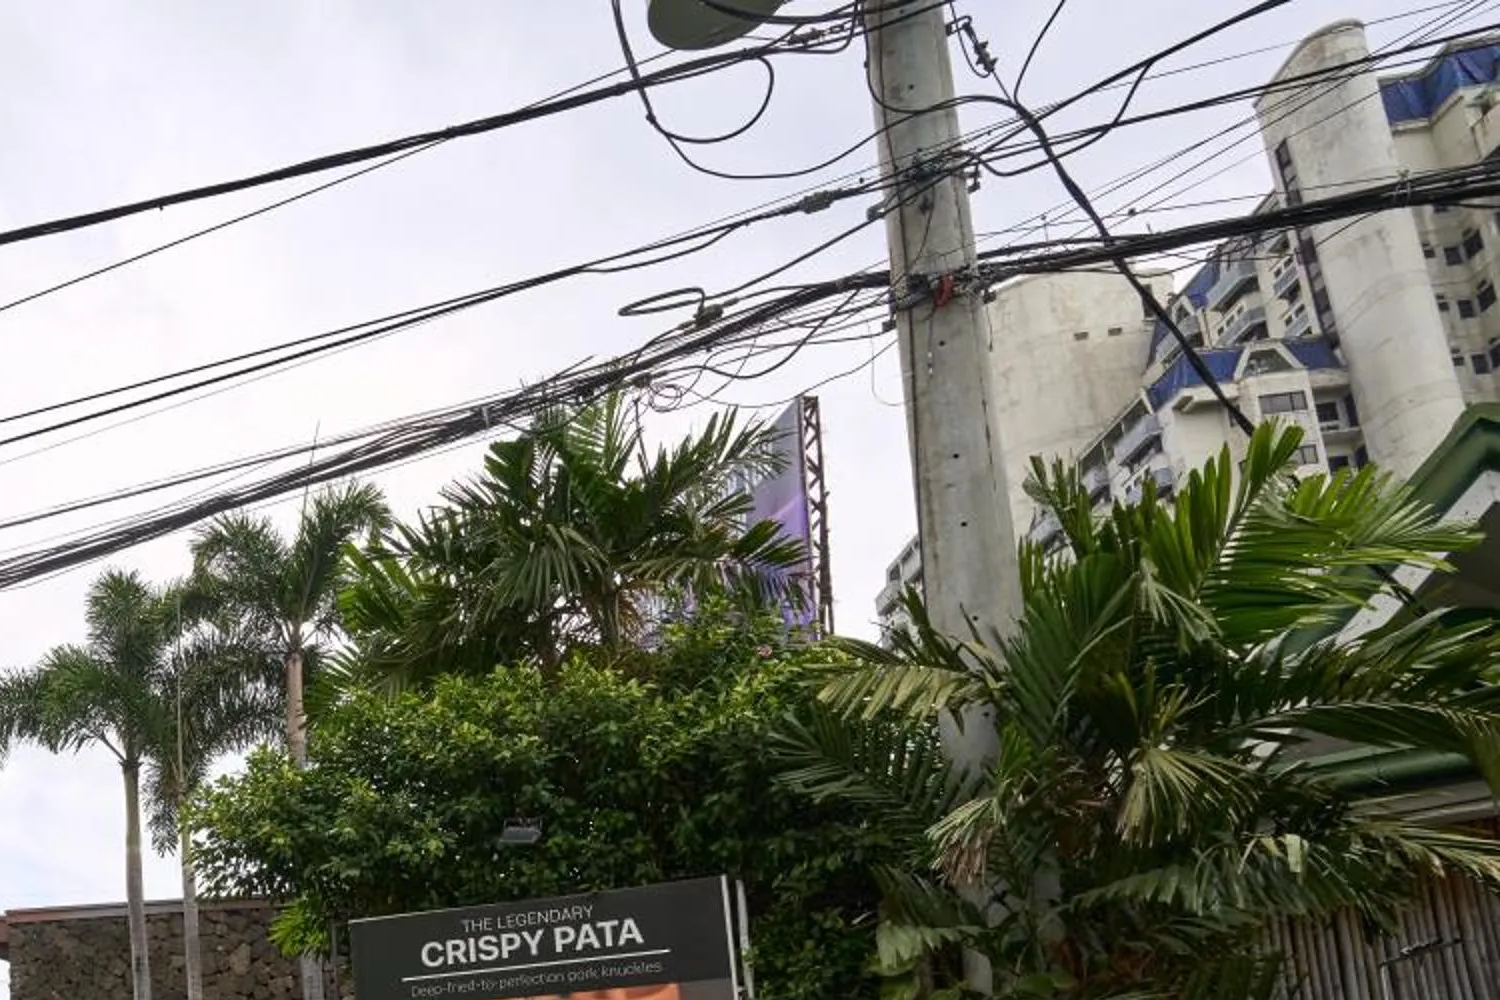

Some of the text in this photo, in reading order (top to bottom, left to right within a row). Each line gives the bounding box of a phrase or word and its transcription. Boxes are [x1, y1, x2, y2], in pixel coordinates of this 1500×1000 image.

[462, 905, 594, 933] THE LEGENDARY
[420, 917, 645, 968] CRISPY PATA
[568, 966, 600, 984] pork
[601, 960, 663, 978] knuckles
